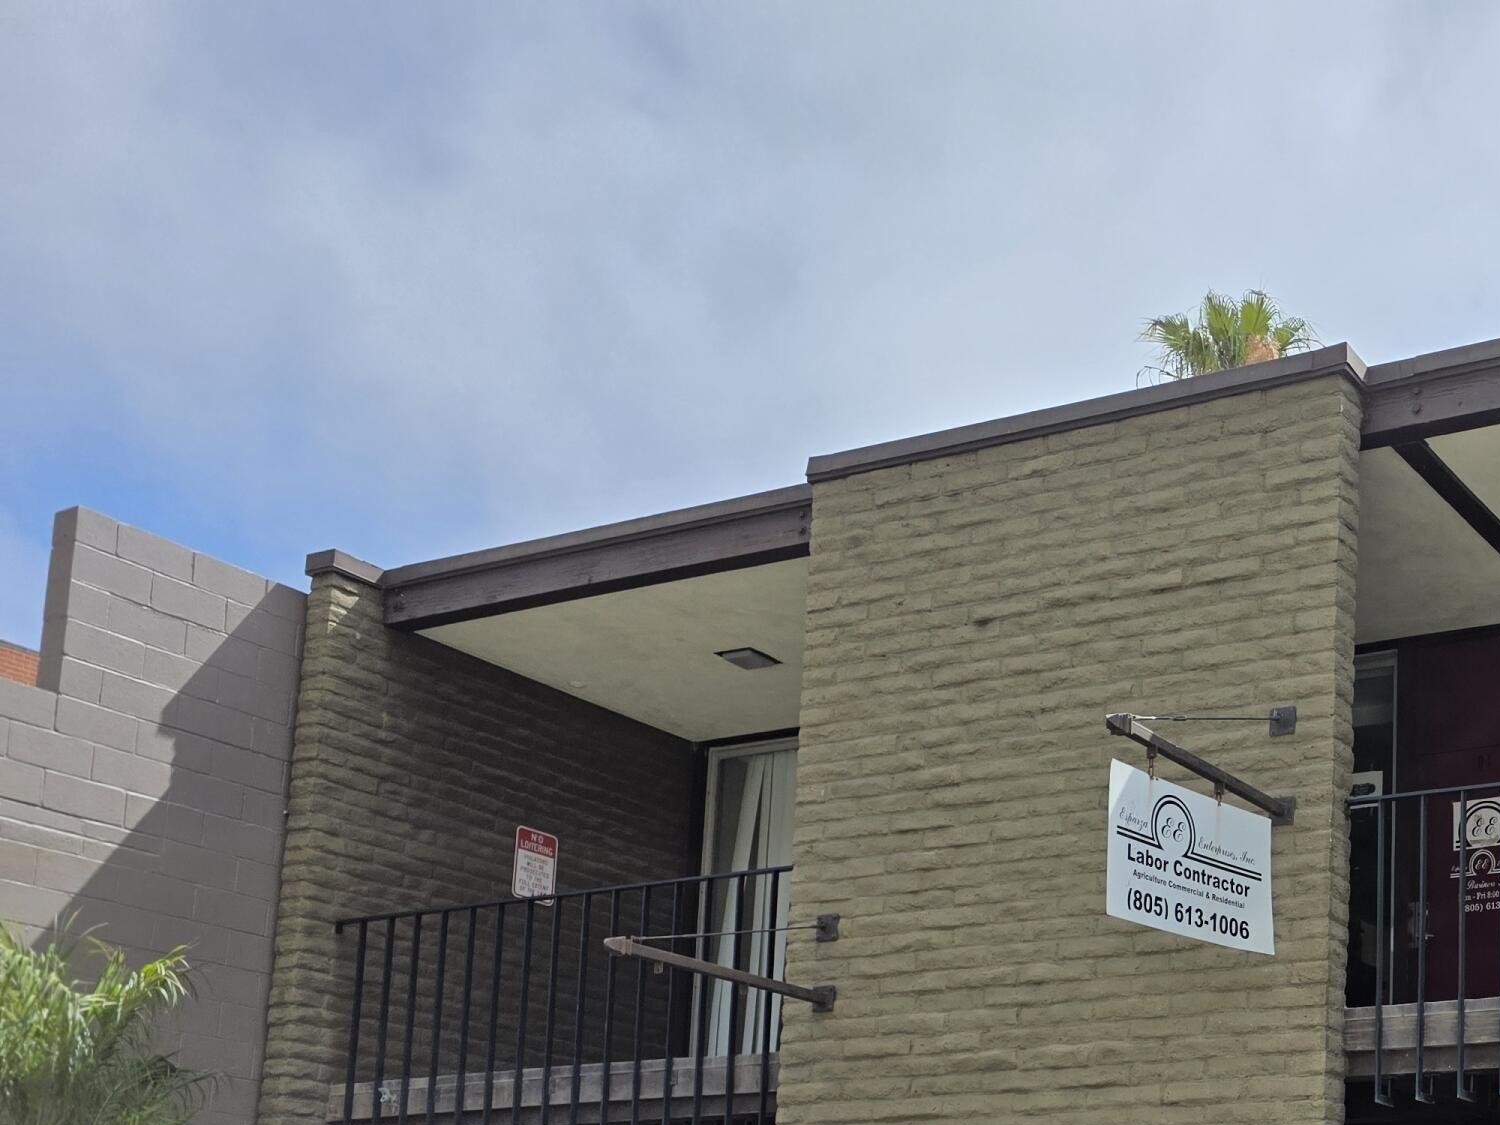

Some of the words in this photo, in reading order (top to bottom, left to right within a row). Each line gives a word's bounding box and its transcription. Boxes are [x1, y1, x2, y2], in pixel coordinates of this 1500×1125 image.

[1119, 806, 1149, 831] Esparza
[520, 839, 553, 857] LOITERING
[531, 832, 544, 843] NO
[1127, 842, 1169, 872] Labor
[1174, 859, 1250, 897] Contractor
[1133, 869, 1167, 886] Agriculture
[1168, 880, 1204, 897] Commercial
[1205, 891, 1210, 899] &
[1211, 894, 1245, 909] Residential
[1127, 887, 1169, 920] (805)
[1174, 902, 1250, 940] 613-1006
